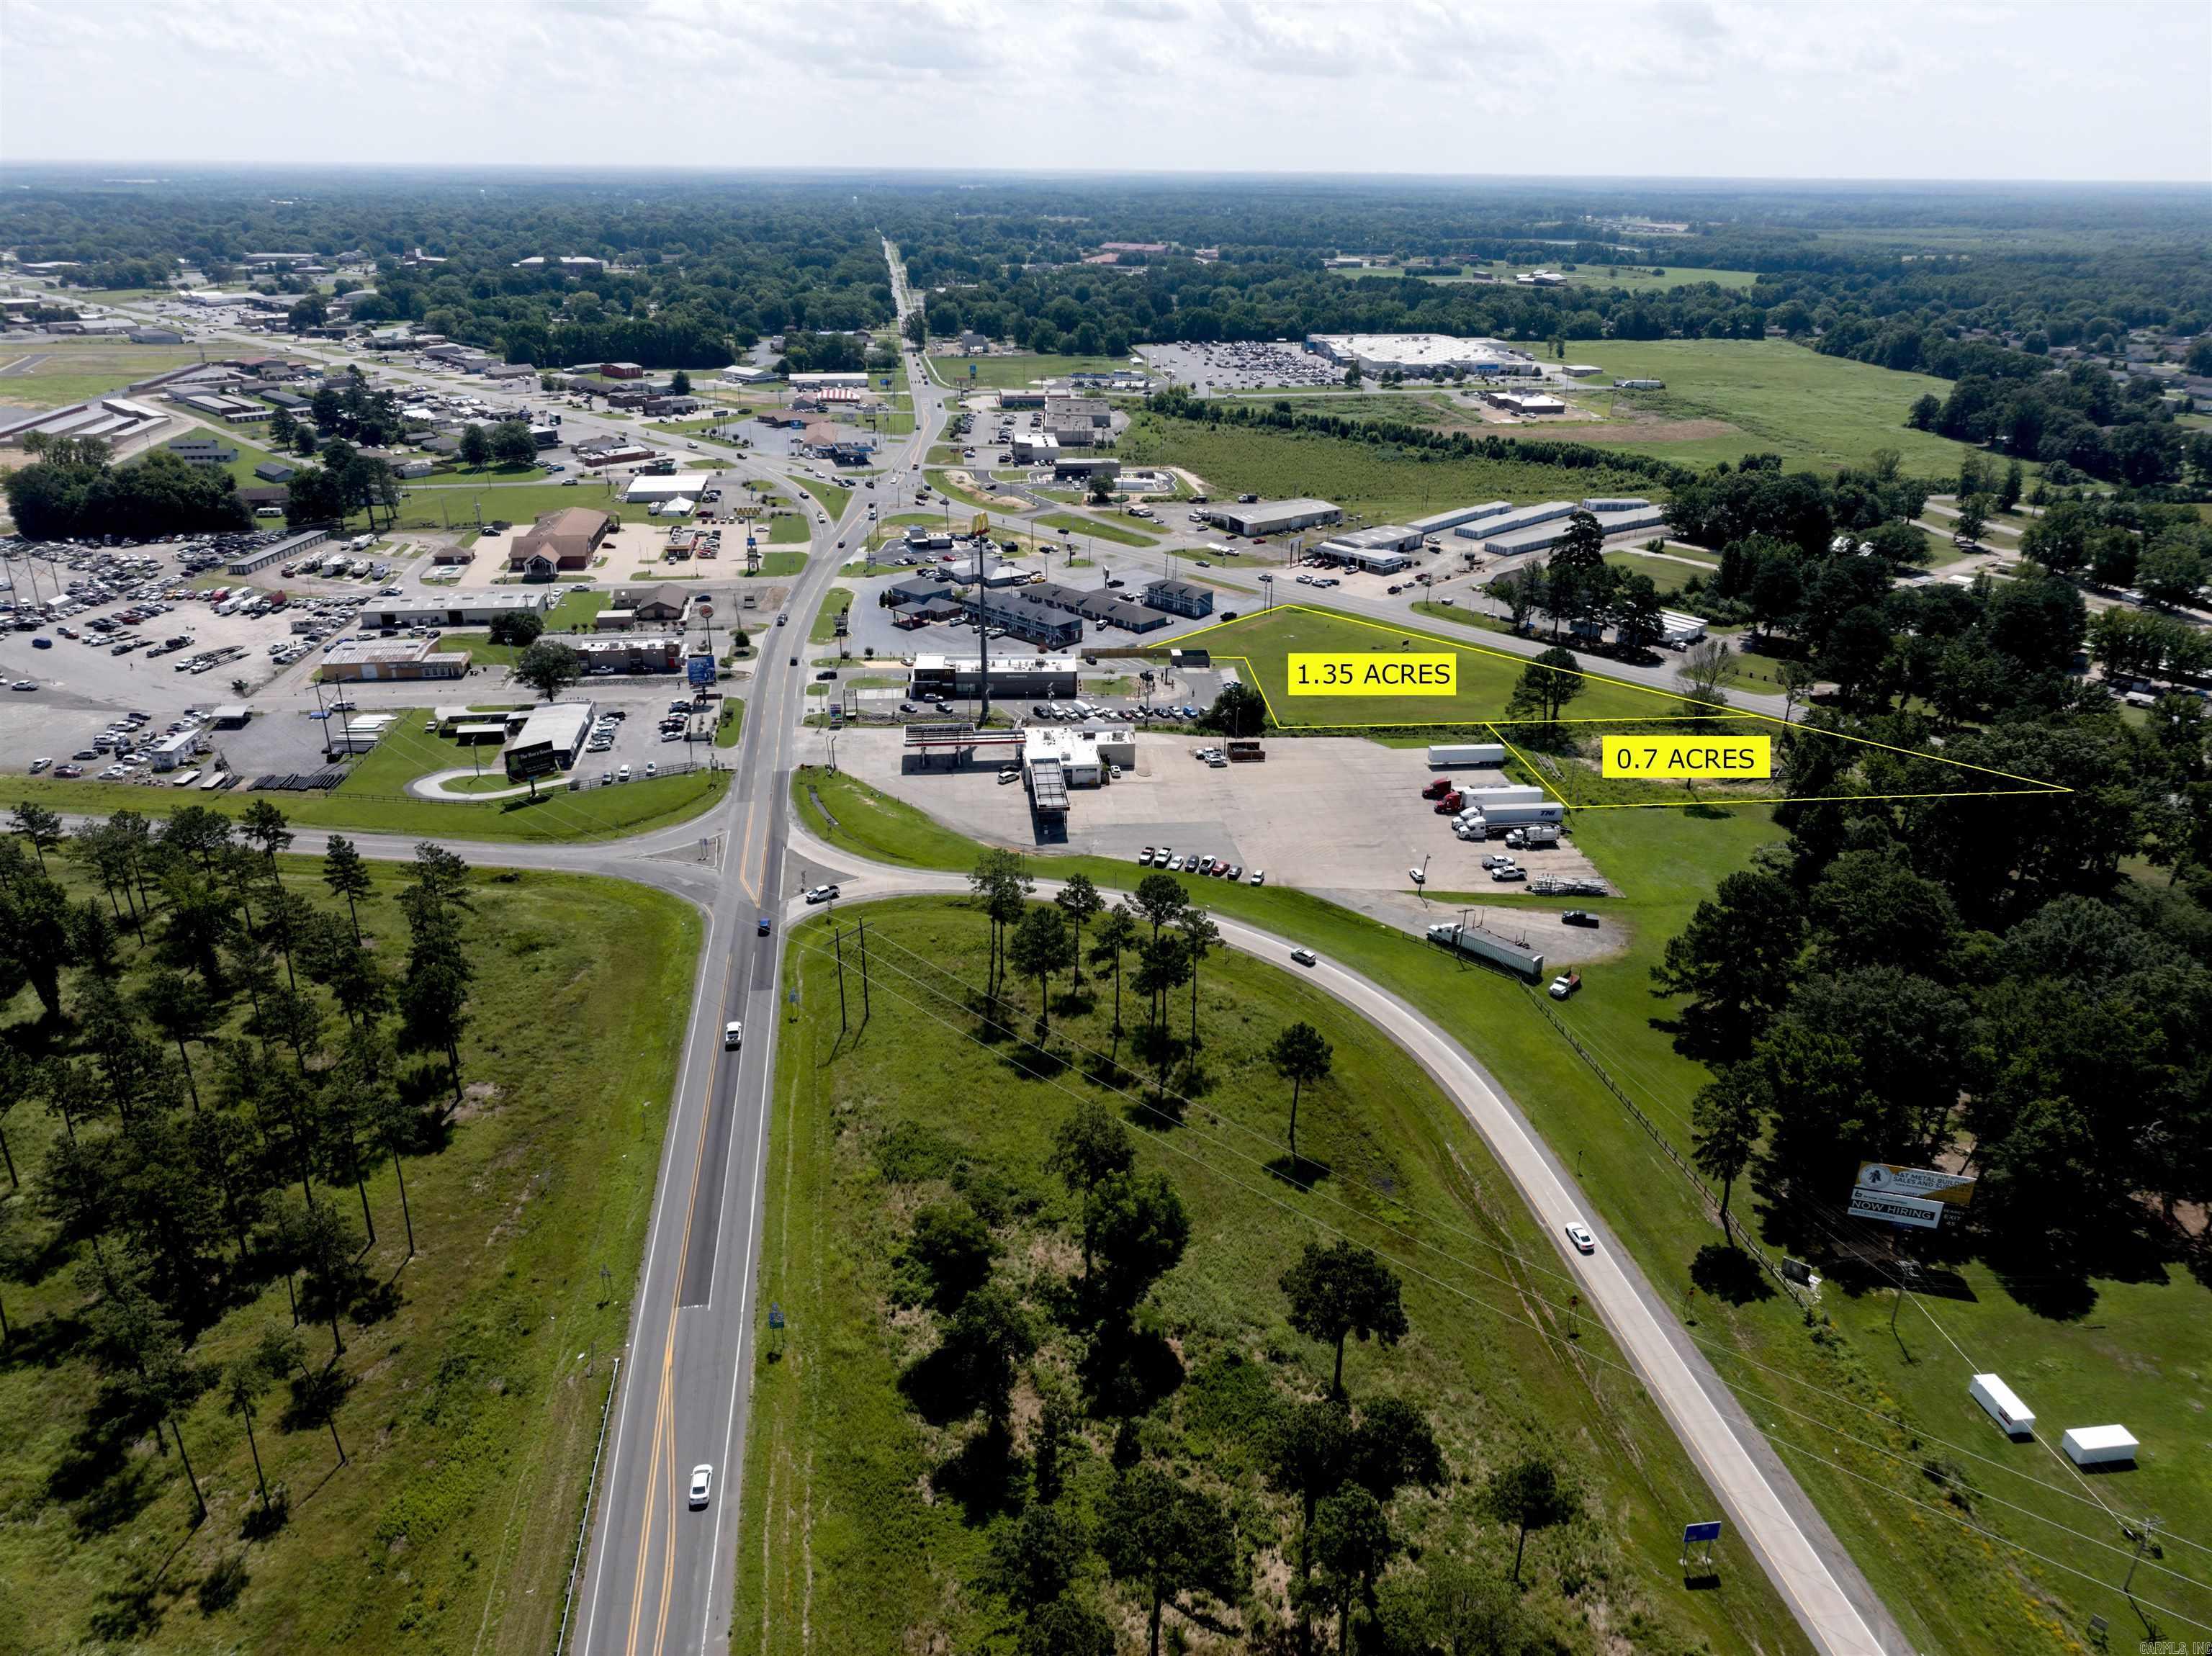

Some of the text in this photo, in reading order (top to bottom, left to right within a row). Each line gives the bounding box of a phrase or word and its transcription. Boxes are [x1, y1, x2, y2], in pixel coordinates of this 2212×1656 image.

[1893, 1176, 1915, 1184] SALES
[1911, 1174, 1936, 1183] METAL
[1851, 1200, 1931, 1220] NOW HIRING
